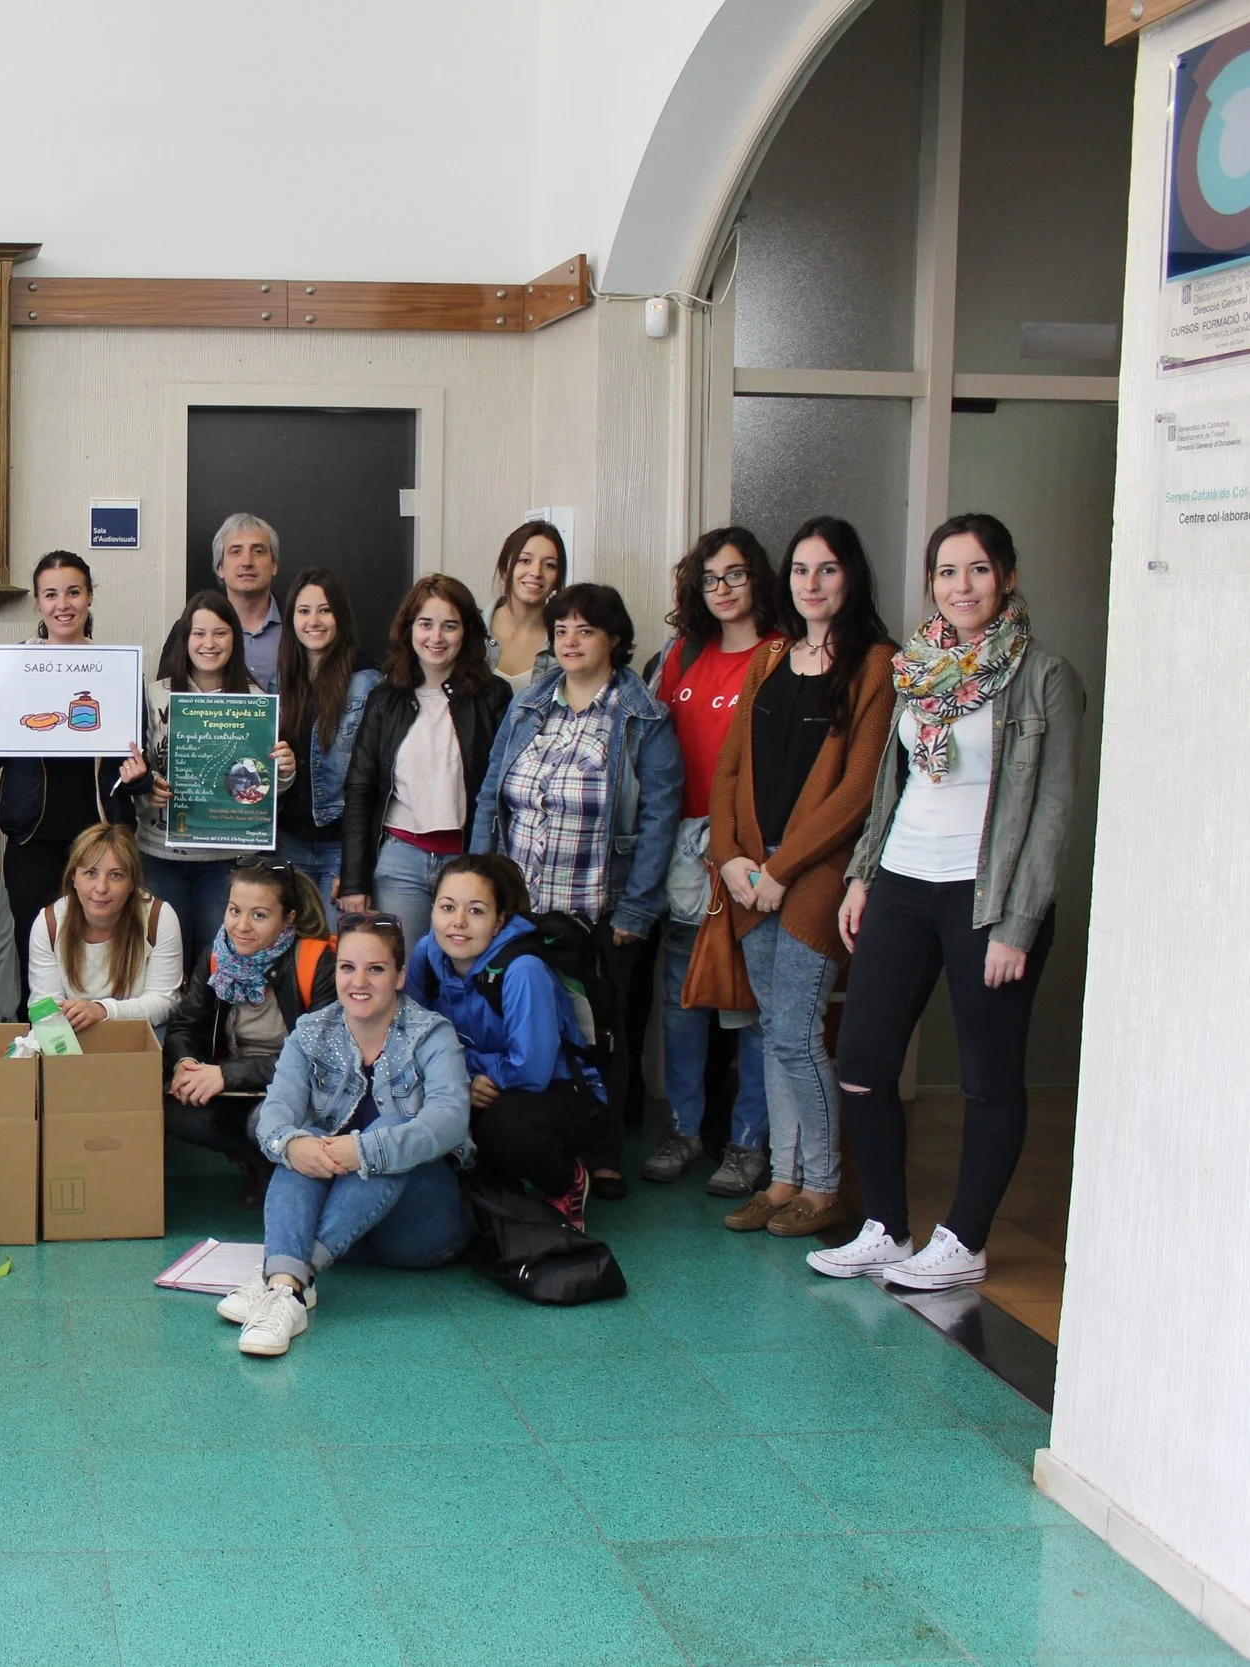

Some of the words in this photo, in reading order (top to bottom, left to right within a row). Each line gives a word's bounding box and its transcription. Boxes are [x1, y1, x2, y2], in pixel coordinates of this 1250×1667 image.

[1194, 303, 1220, 316] Direcció
[1221, 294, 1248, 309] General
[1171, 322, 1199, 338] CURSOS
[1202, 312, 1240, 331] FORMACIÓ
[1166, 491, 1190, 503] Servei
[1191, 488, 1218, 502] Català
[1219, 487, 1230, 499] de
[1178, 512, 1206, 524] Centre
[93, 535, 136, 543] d'Audiovisuals
[24, 660, 54, 673] SABÓ
[56, 663, 62, 672] I
[65, 661, 103, 673] XAMPÚ
[182, 707, 223, 718] Campanya
[225, 708, 252, 719] d'ajuda
[253, 709, 267, 717] als
[202, 720, 246, 730] Temporers
[176, 731, 186, 740] En
[198, 732, 212, 743] pots
[213, 731, 250, 741] contribuir?
